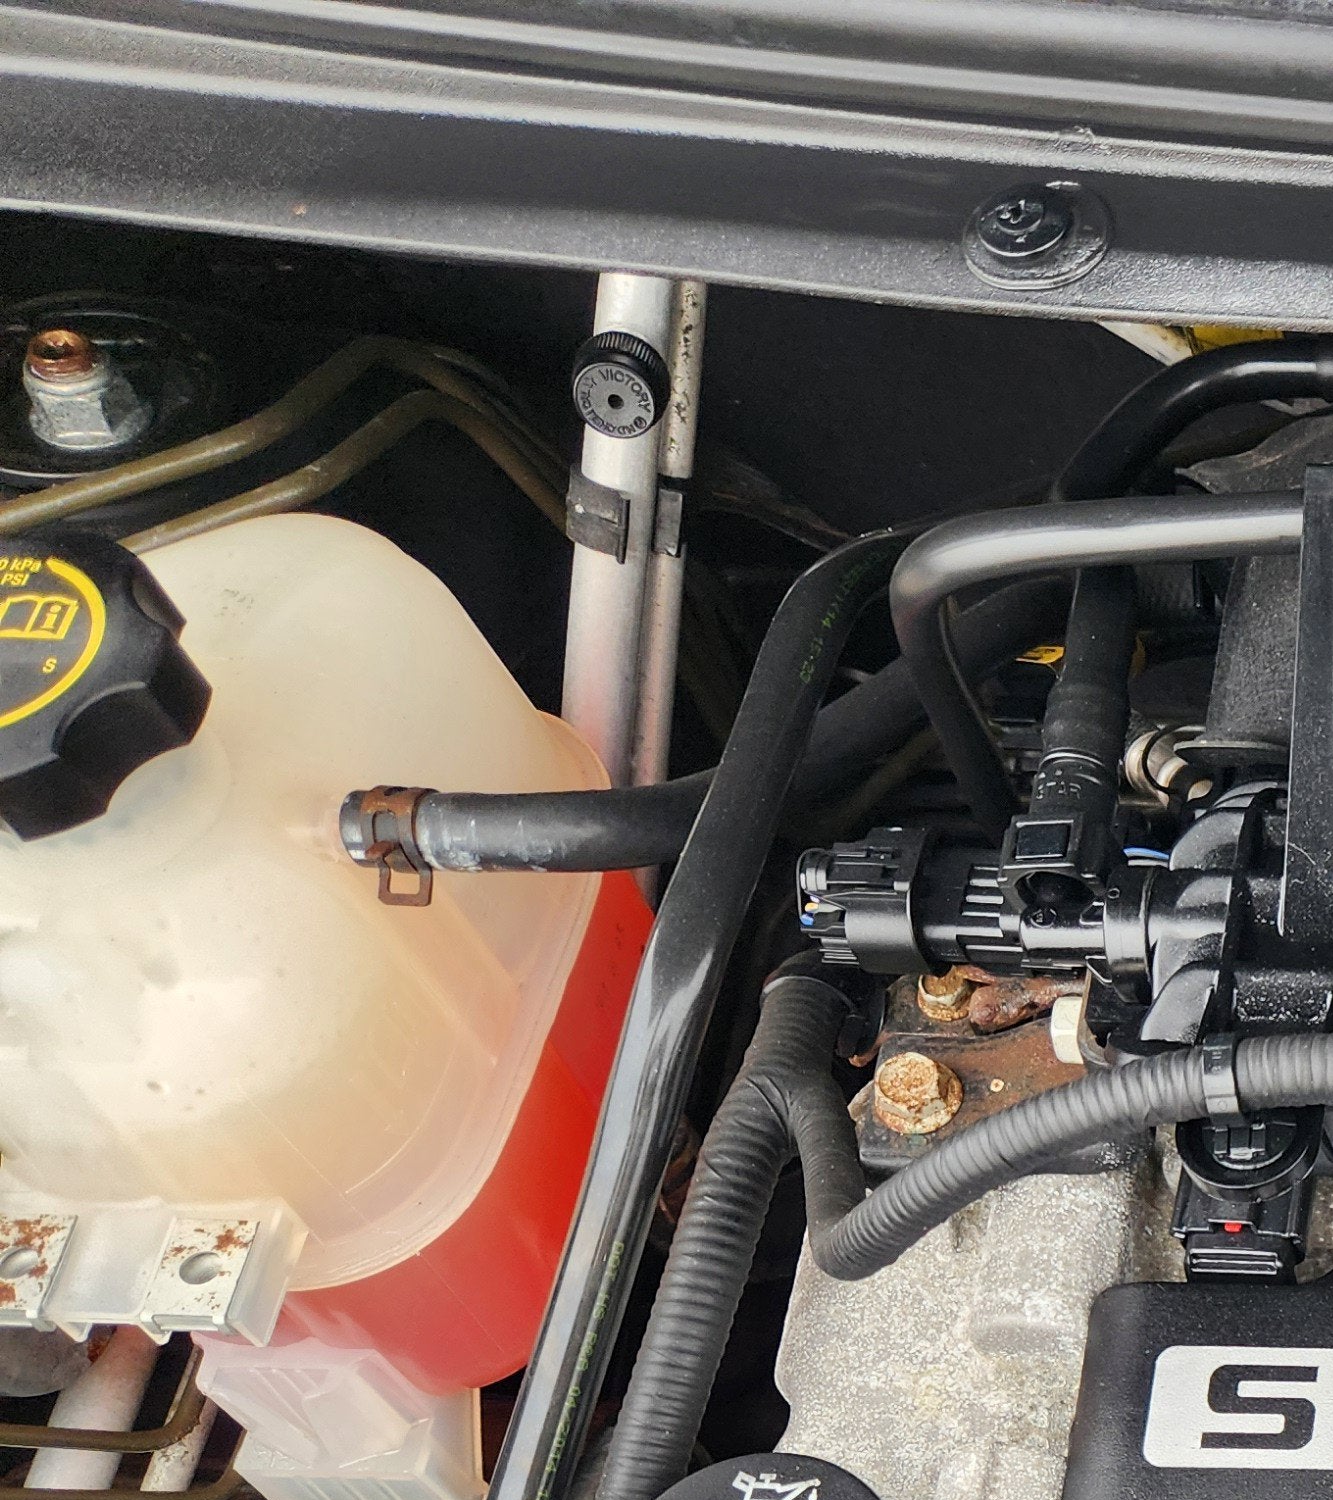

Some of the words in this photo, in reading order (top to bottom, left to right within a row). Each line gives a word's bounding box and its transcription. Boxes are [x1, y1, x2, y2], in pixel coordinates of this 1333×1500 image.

[598, 367, 651, 413] VICTORY
[12, 558, 41, 573] kPa
[2, 573, 30, 586] PSI
